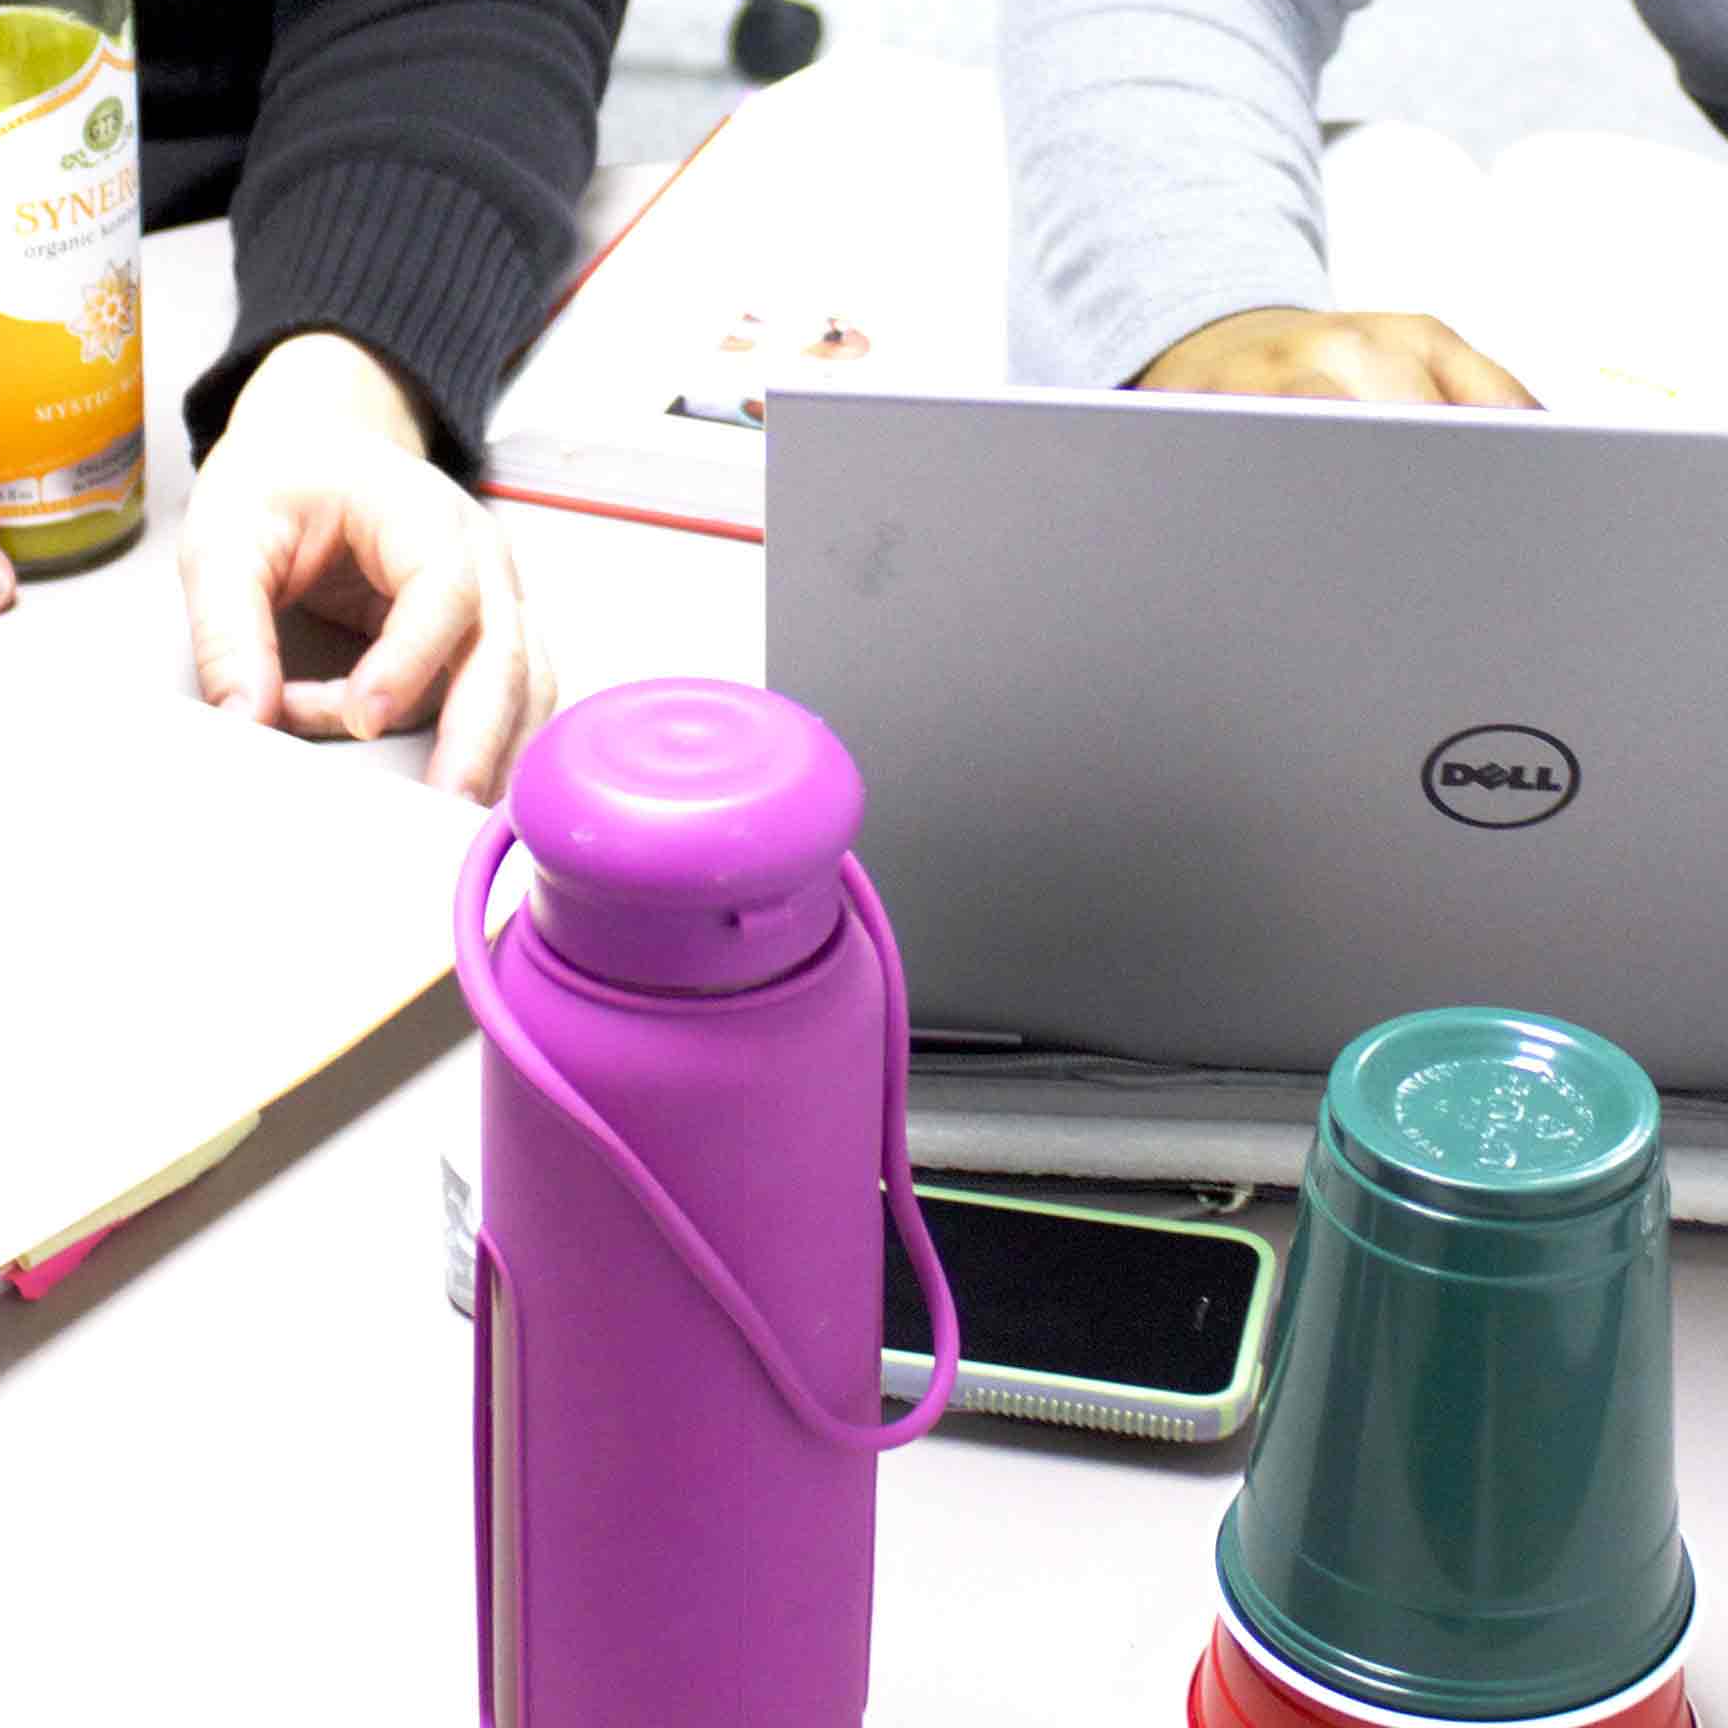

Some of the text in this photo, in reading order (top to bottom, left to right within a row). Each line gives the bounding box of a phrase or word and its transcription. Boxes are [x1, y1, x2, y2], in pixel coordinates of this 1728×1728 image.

[15, 165, 137, 238] SYNER
[24, 230, 95, 259] organic
[34, 386, 113, 422] MYSTIC
[1440, 761, 1563, 792] DELL
